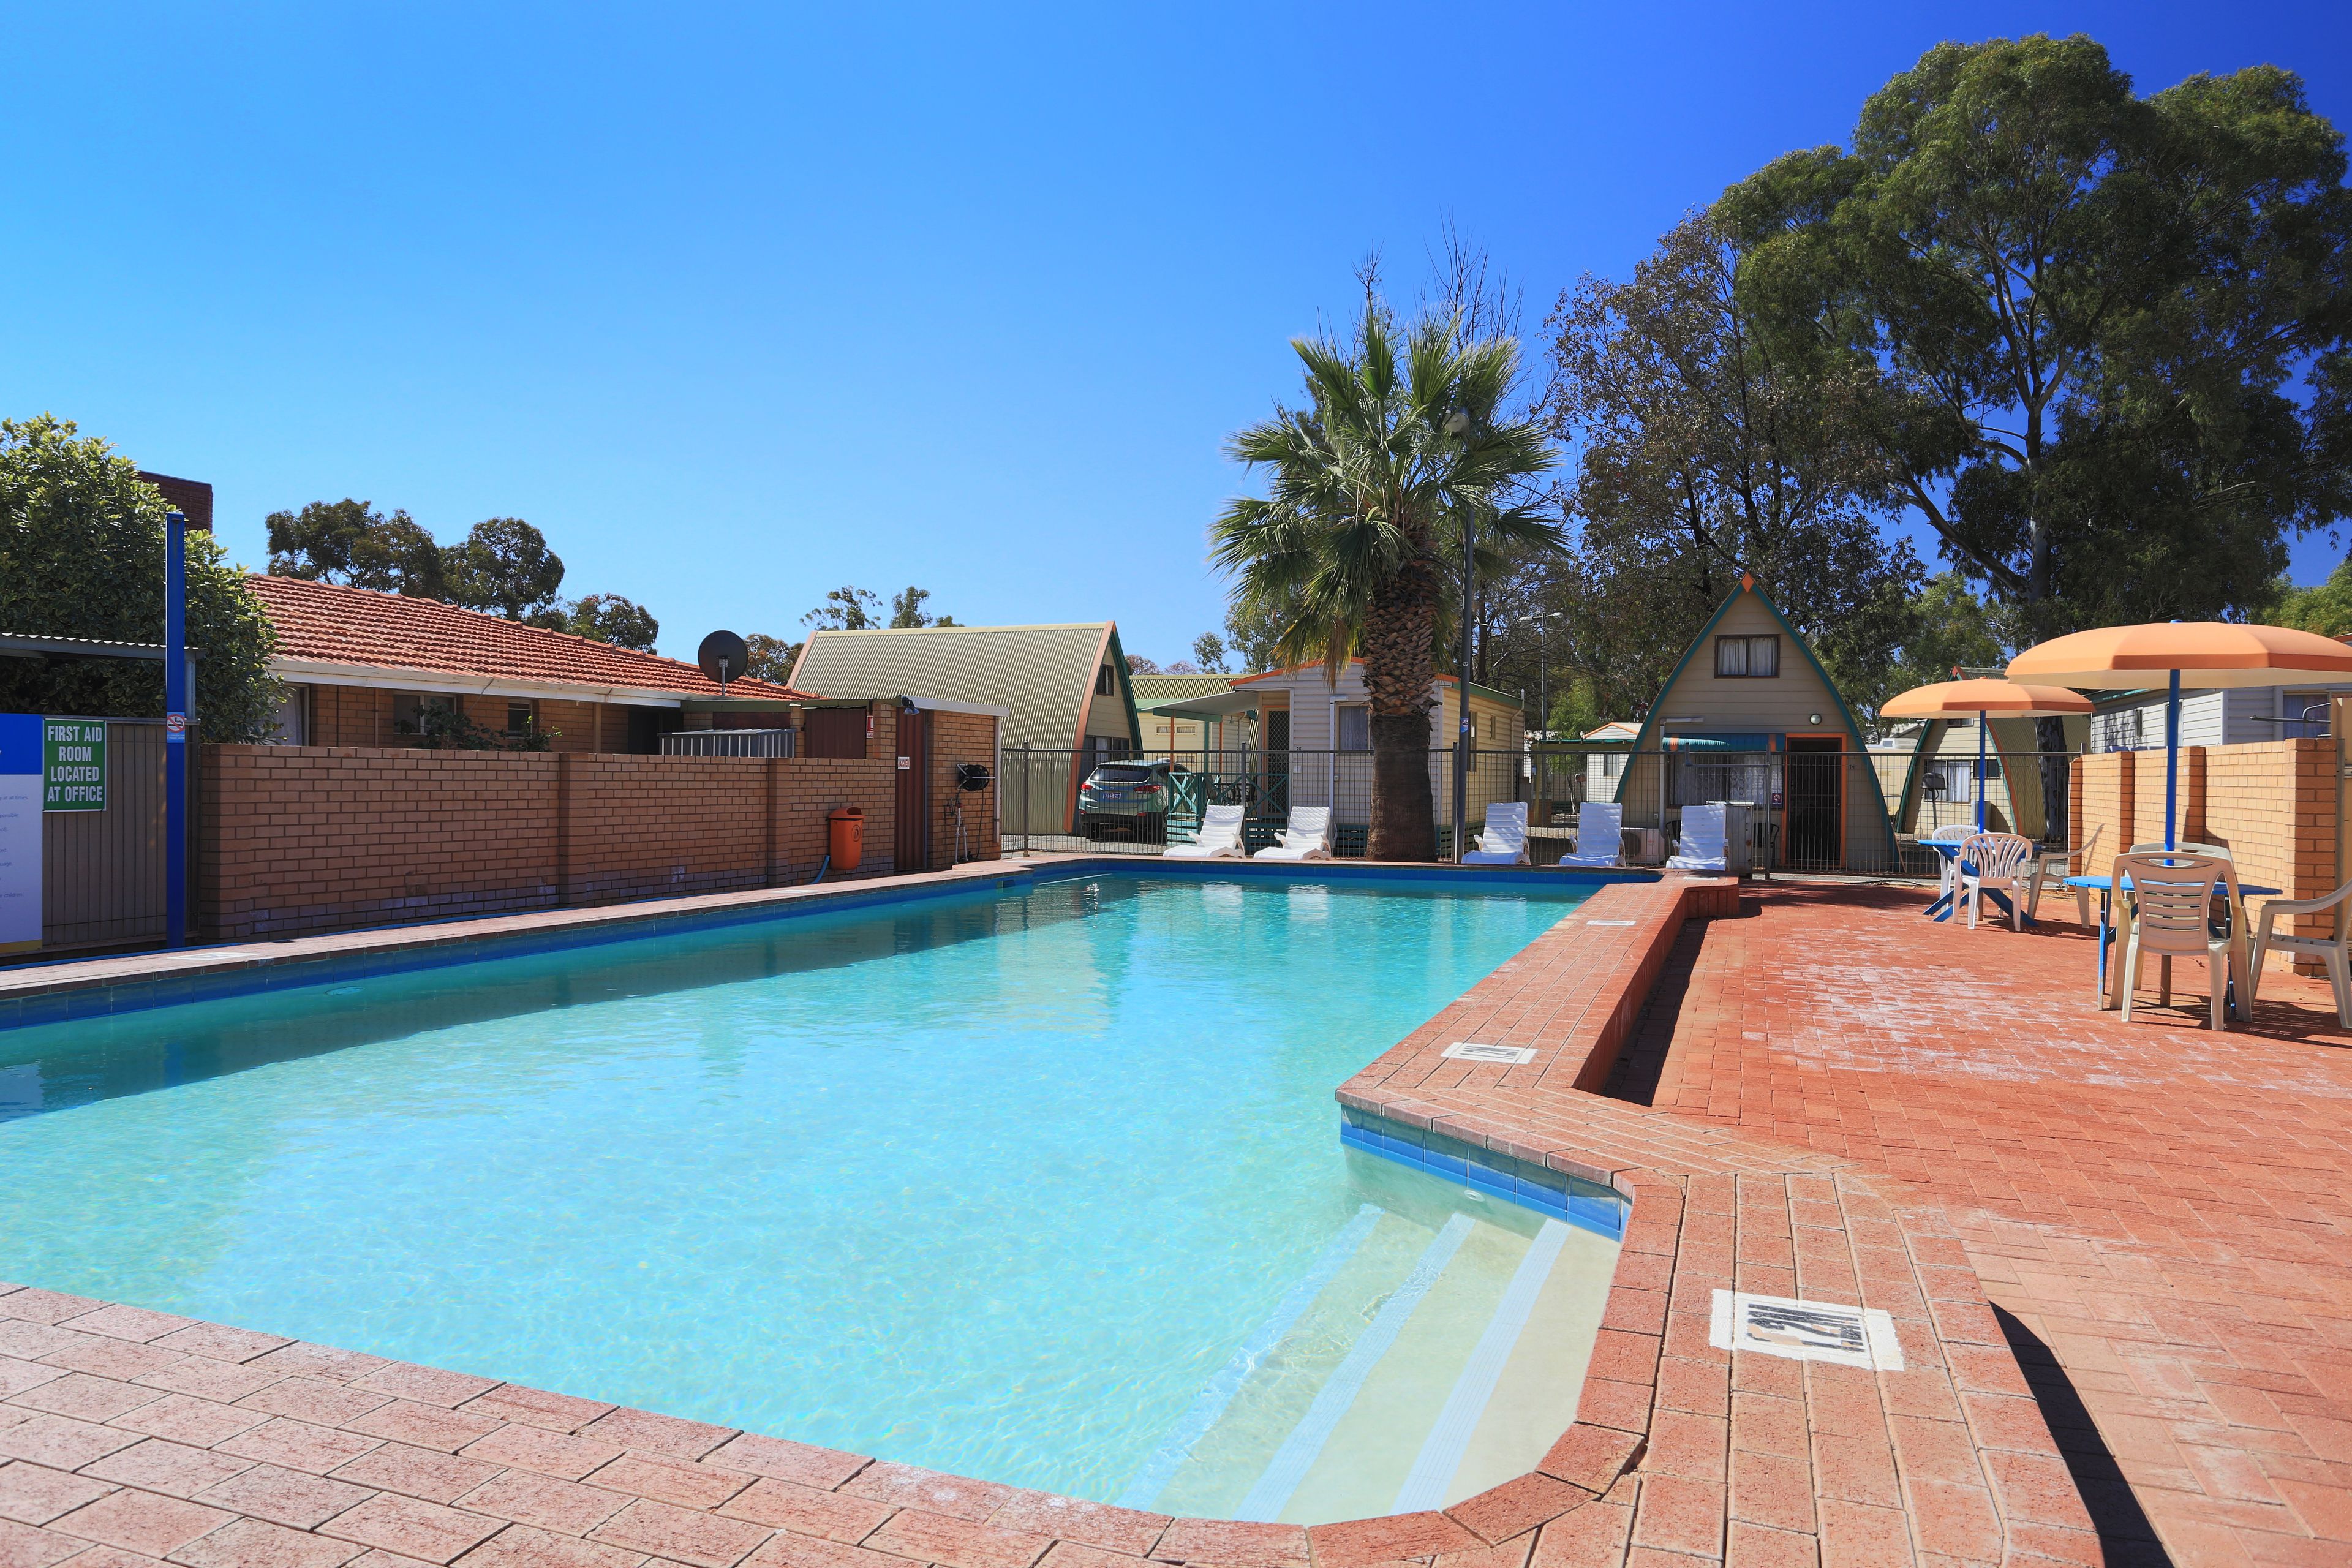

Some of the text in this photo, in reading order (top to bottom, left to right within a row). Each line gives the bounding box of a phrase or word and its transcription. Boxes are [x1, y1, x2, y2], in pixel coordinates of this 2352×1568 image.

[48, 725, 102, 742] FIRST AID
[59, 746, 92, 761] ROOM
[51, 766, 99, 782] LOCATED
[47, 786, 103, 802] AT OFFICE
